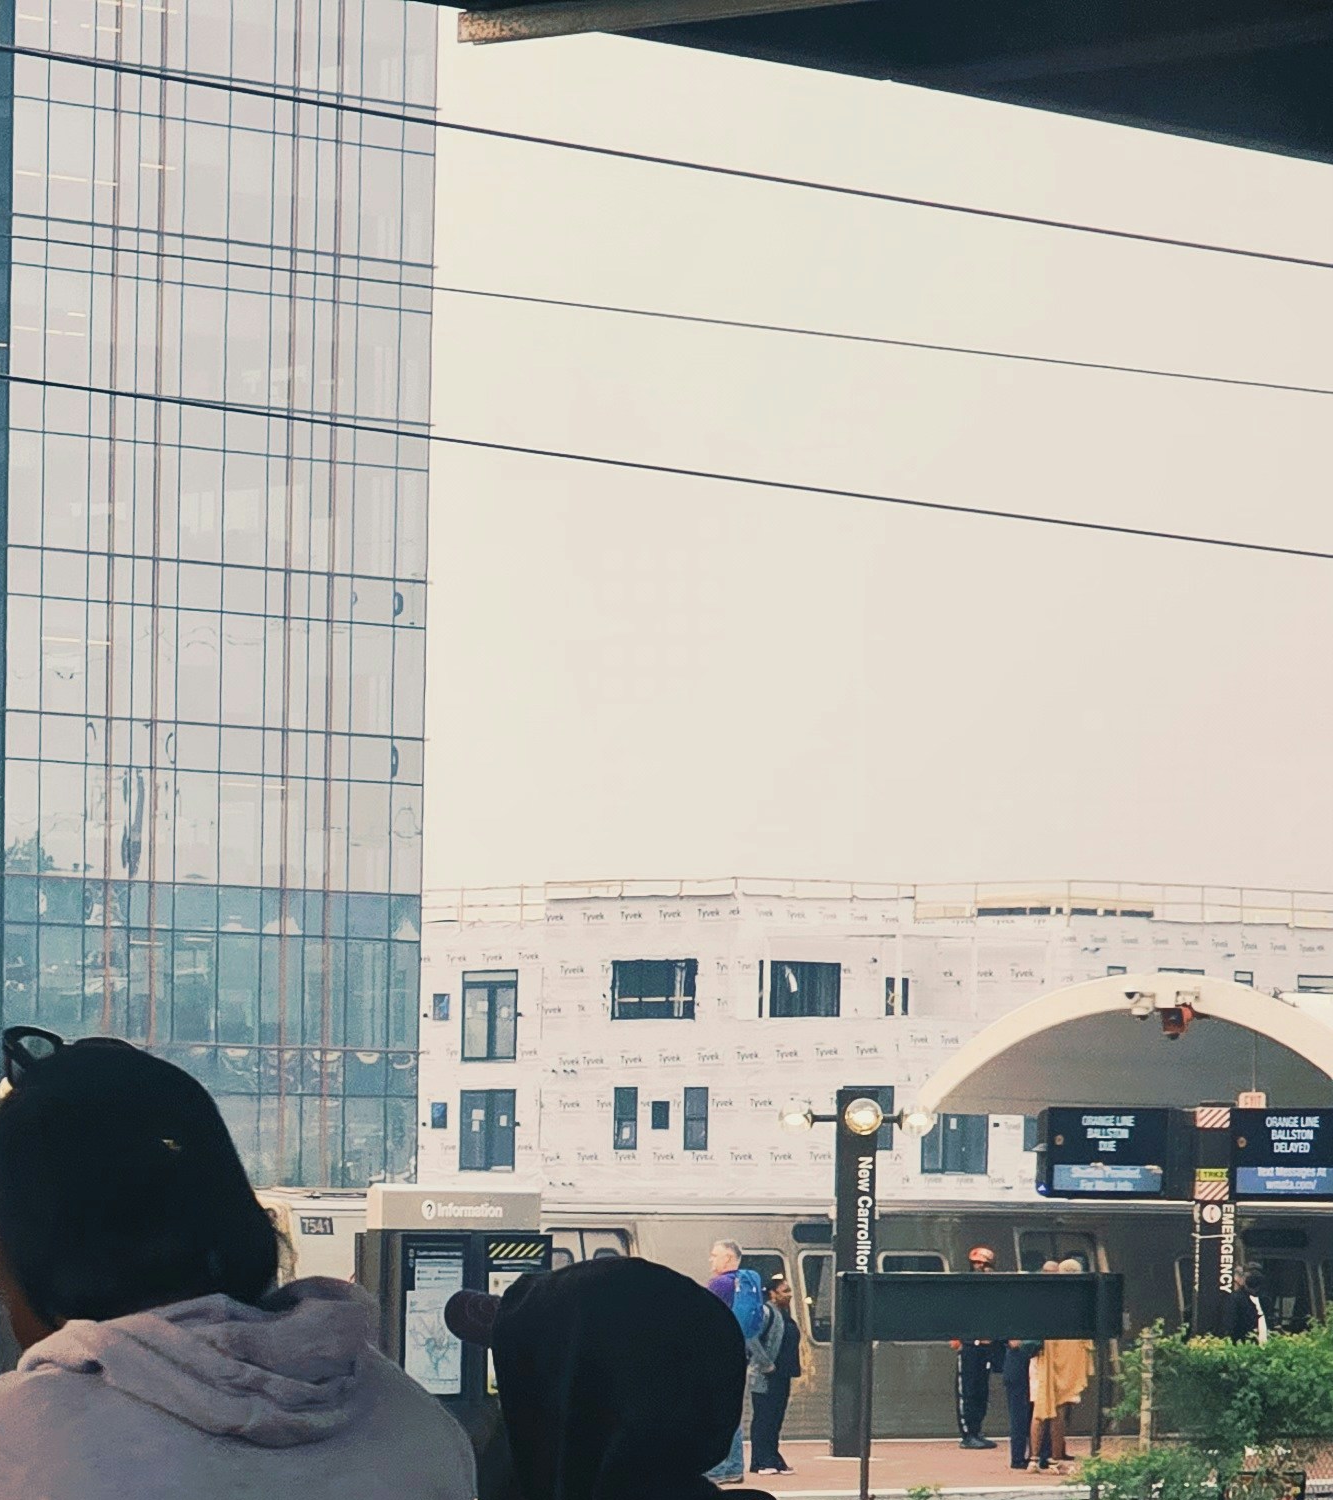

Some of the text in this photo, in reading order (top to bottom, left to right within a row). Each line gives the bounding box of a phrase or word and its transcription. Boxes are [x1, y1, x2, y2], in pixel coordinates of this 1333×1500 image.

[1265, 1115, 1320, 1128] ORANGE LINE
[1271, 1129, 1314, 1140] BALLSTON
[1273, 1142, 1310, 1153] DELAYED
[857, 1156, 873, 1192] New
[437, 1203, 503, 1218] Information
[302, 1218, 332, 1234] 7541
[1219, 1203, 1235, 1294] EMERGENCY
